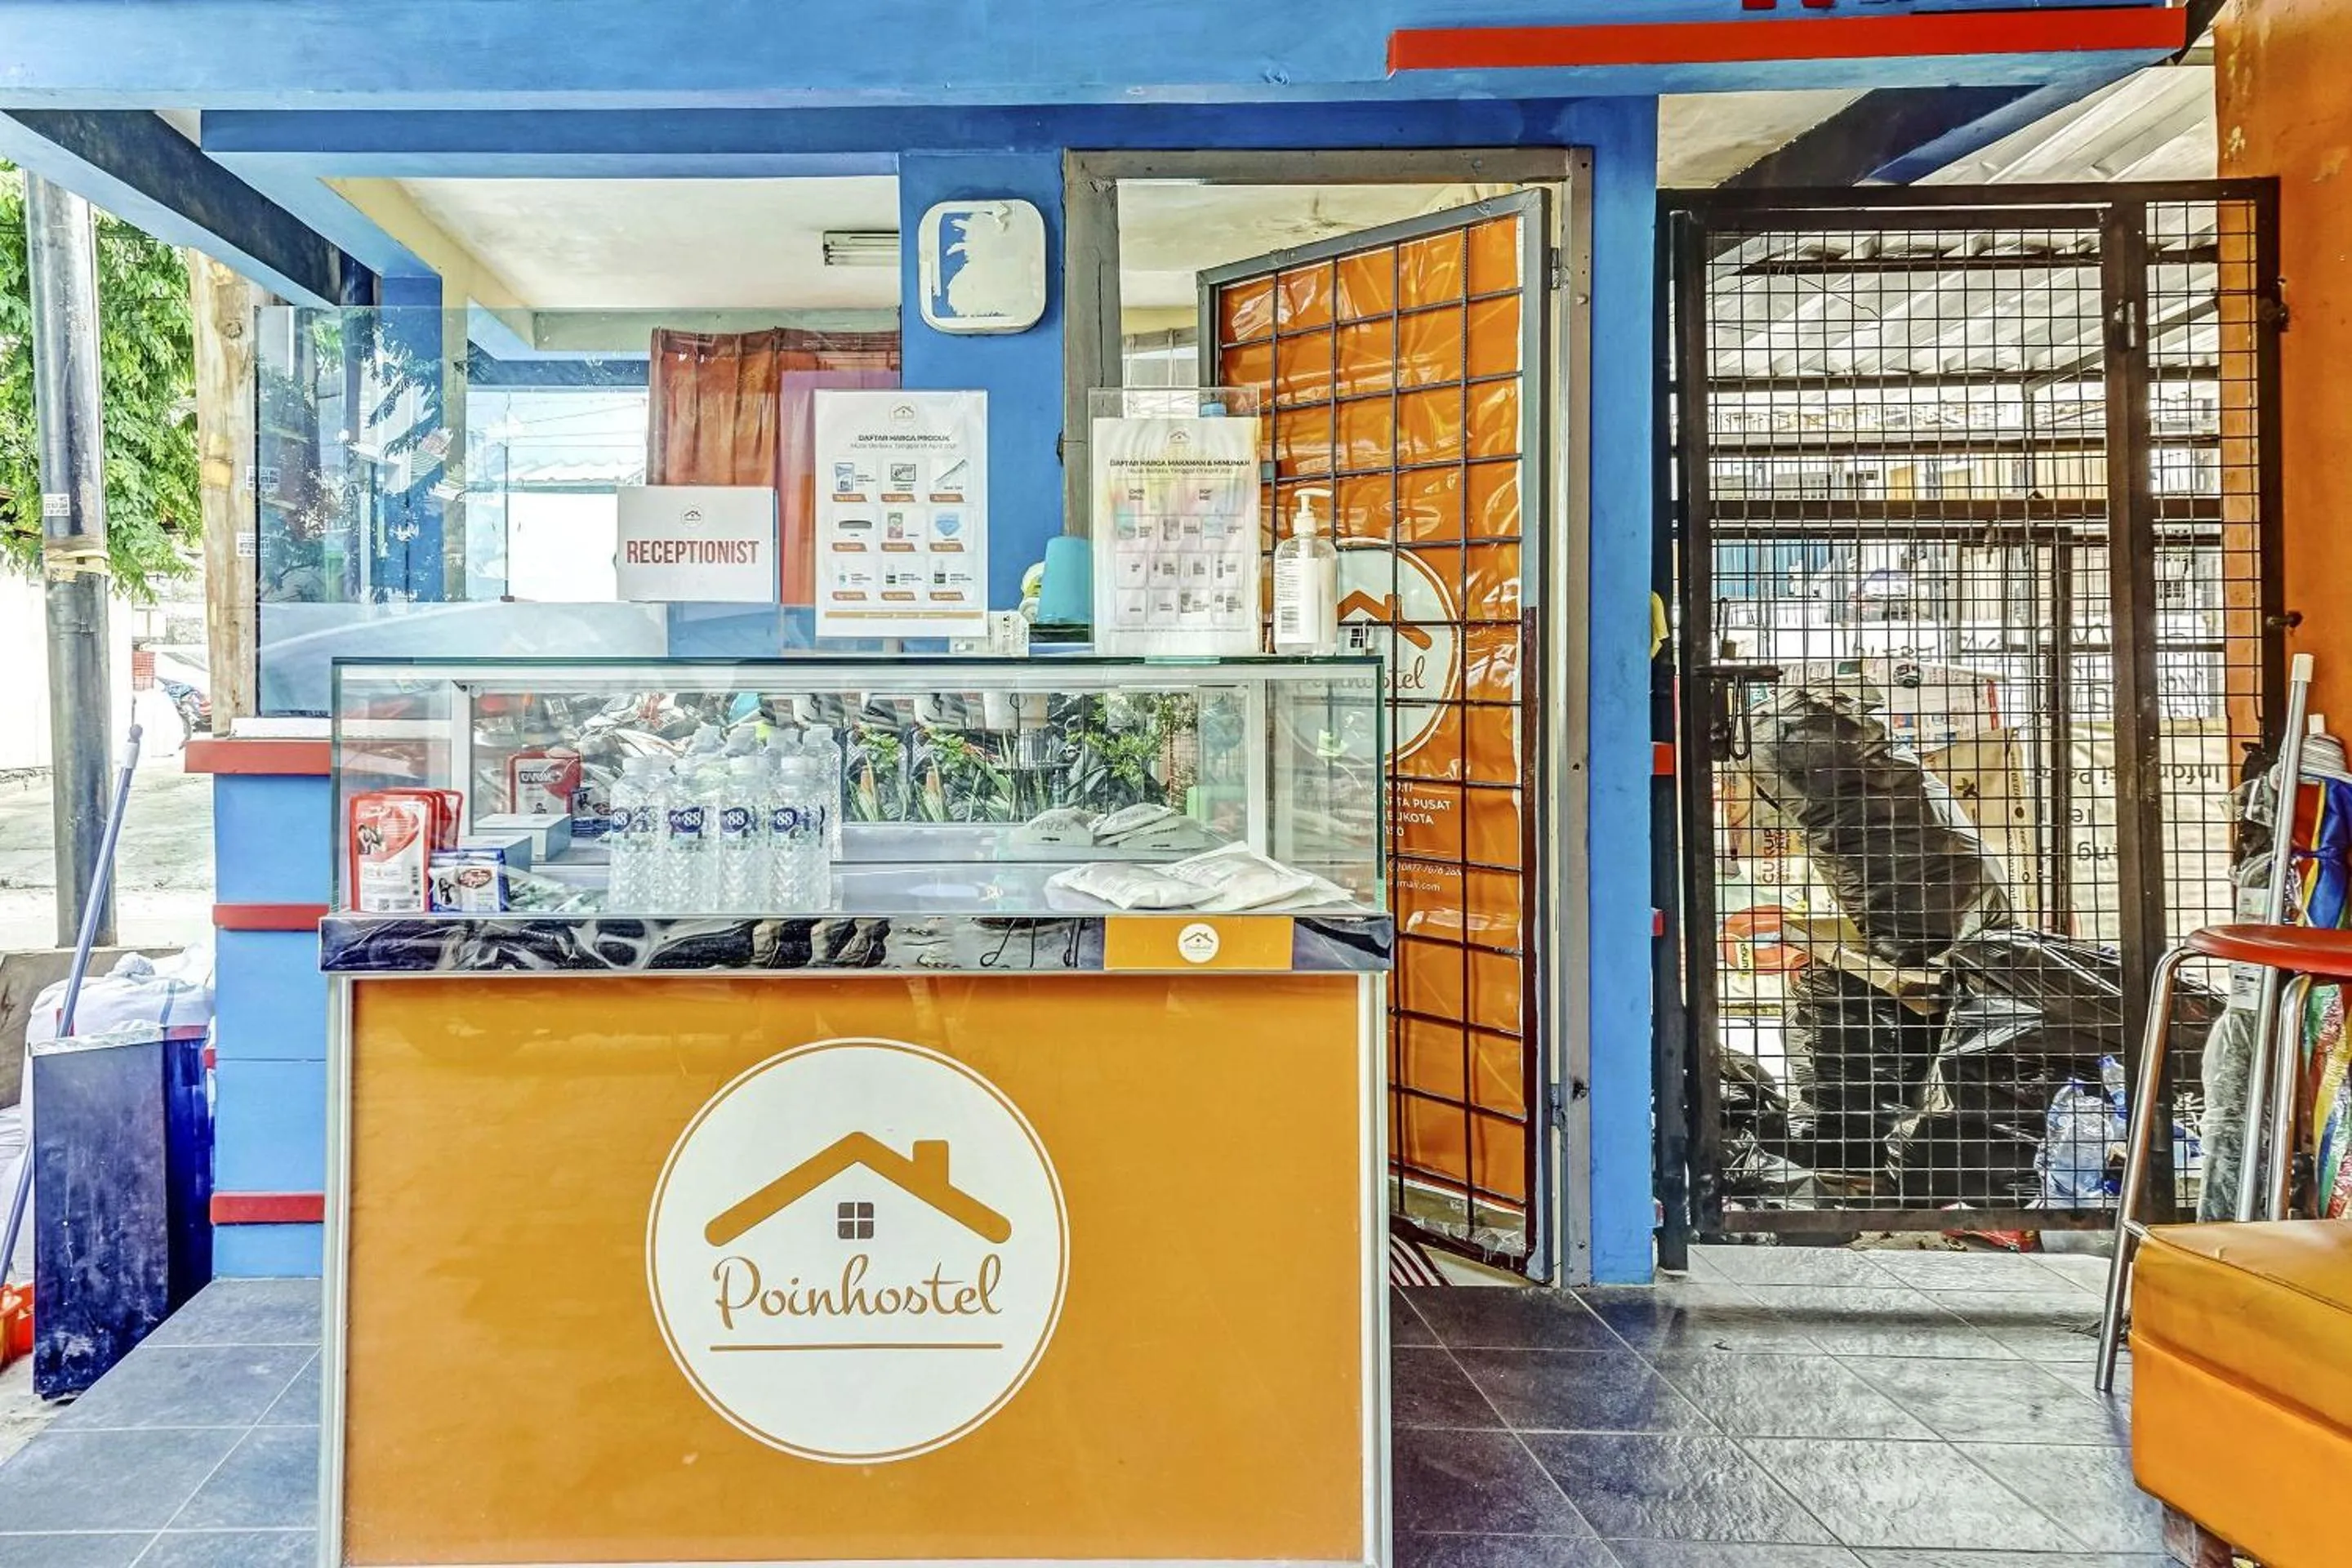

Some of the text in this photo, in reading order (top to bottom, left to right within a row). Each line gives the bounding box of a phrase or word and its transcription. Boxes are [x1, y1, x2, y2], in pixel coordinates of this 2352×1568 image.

[626, 540, 760, 564] RECEPTIONIST
[1413, 799, 1451, 810] PUSAT
[713, 1254, 1004, 1330] Poinhostel
